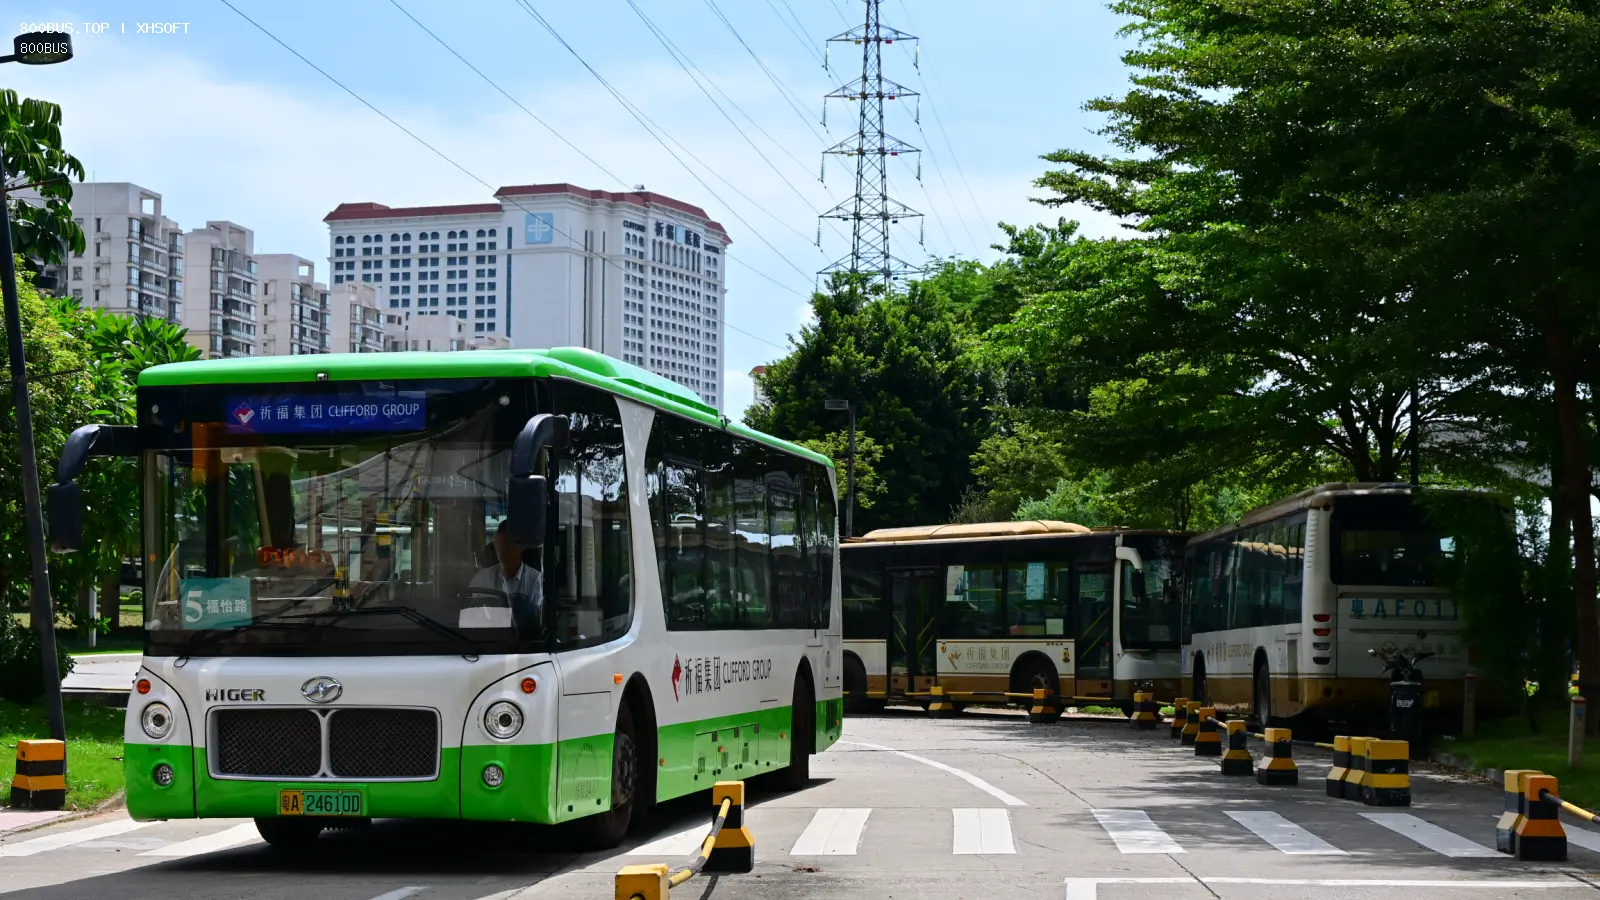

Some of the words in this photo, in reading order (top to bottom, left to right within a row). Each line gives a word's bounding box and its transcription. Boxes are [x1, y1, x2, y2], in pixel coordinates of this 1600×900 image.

[259, 404, 323, 420] 祈福集团
[328, 405, 378, 418] CLIFFORD
[382, 403, 420, 416] GROUP
[185, 590, 203, 623] 5
[206, 599, 248, 614] 福怡路
[684, 655, 721, 696] 祈福集团
[723, 660, 751, 684] CLIFFORD
[752, 658, 772, 680] GROUP
[205, 688, 266, 702] HIGER
